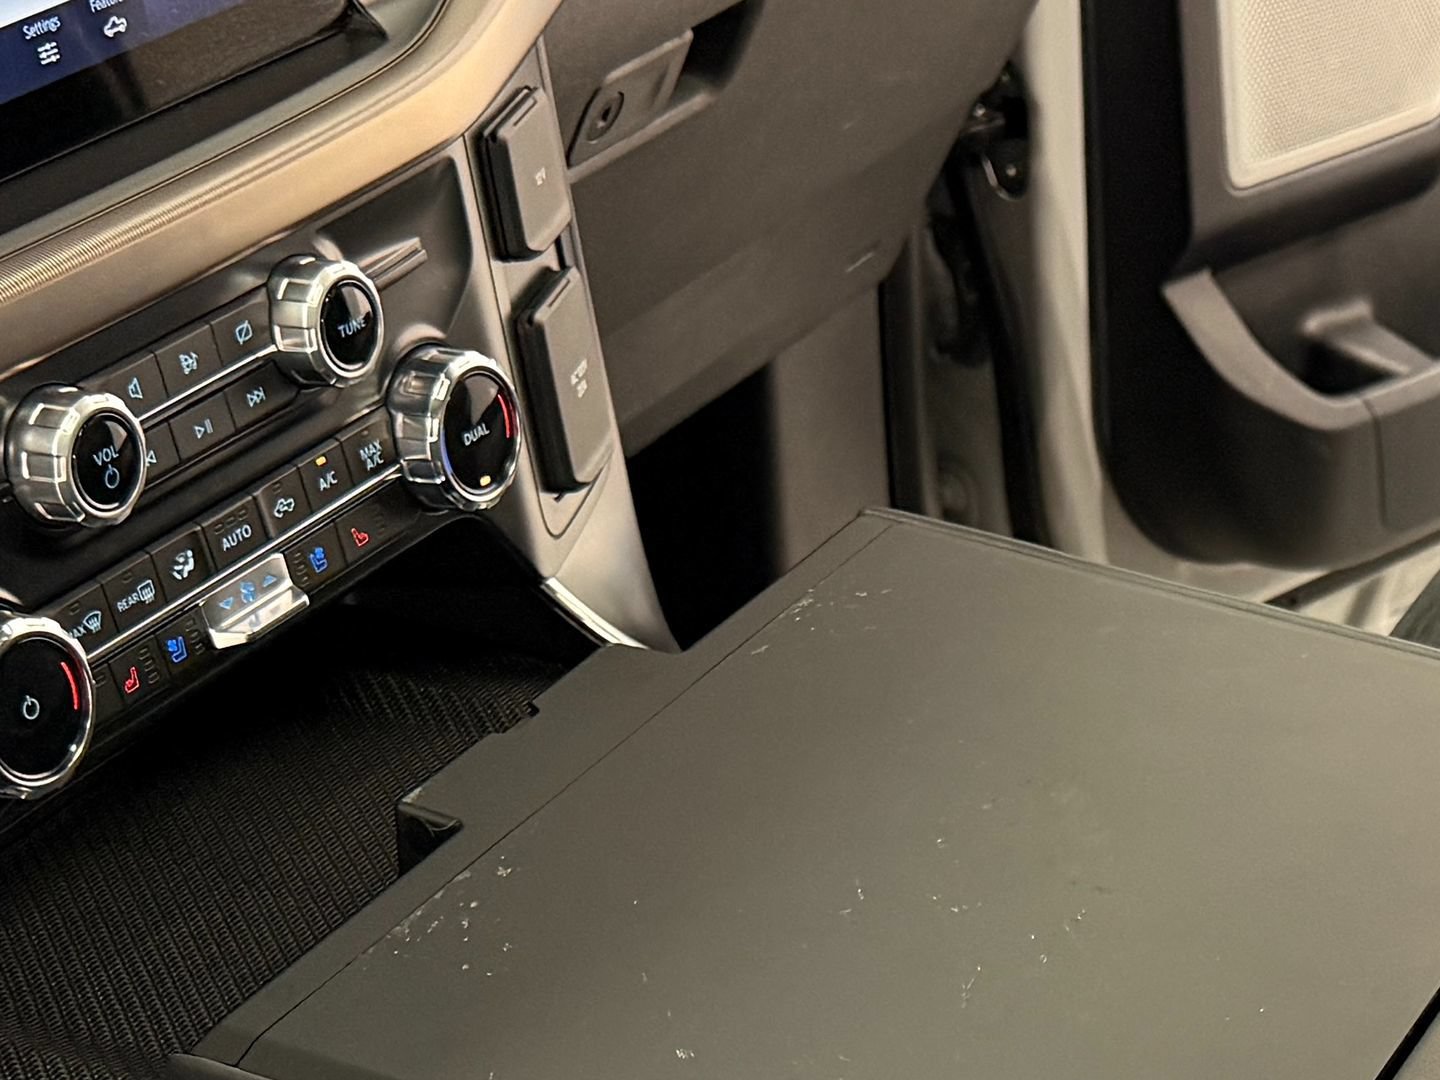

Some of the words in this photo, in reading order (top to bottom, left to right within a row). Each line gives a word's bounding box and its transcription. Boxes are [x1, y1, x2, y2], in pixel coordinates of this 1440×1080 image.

[22, 16, 61, 40] Settings
[337, 316, 367, 338] TUNE
[463, 422, 490, 446] DUAL
[92, 444, 119, 467] VOL
[360, 439, 383, 461] MAX
[365, 451, 385, 471] A/C
[319, 470, 338, 491] A/C
[222, 524, 252, 552] AUTO
[116, 592, 140, 612] REAR
